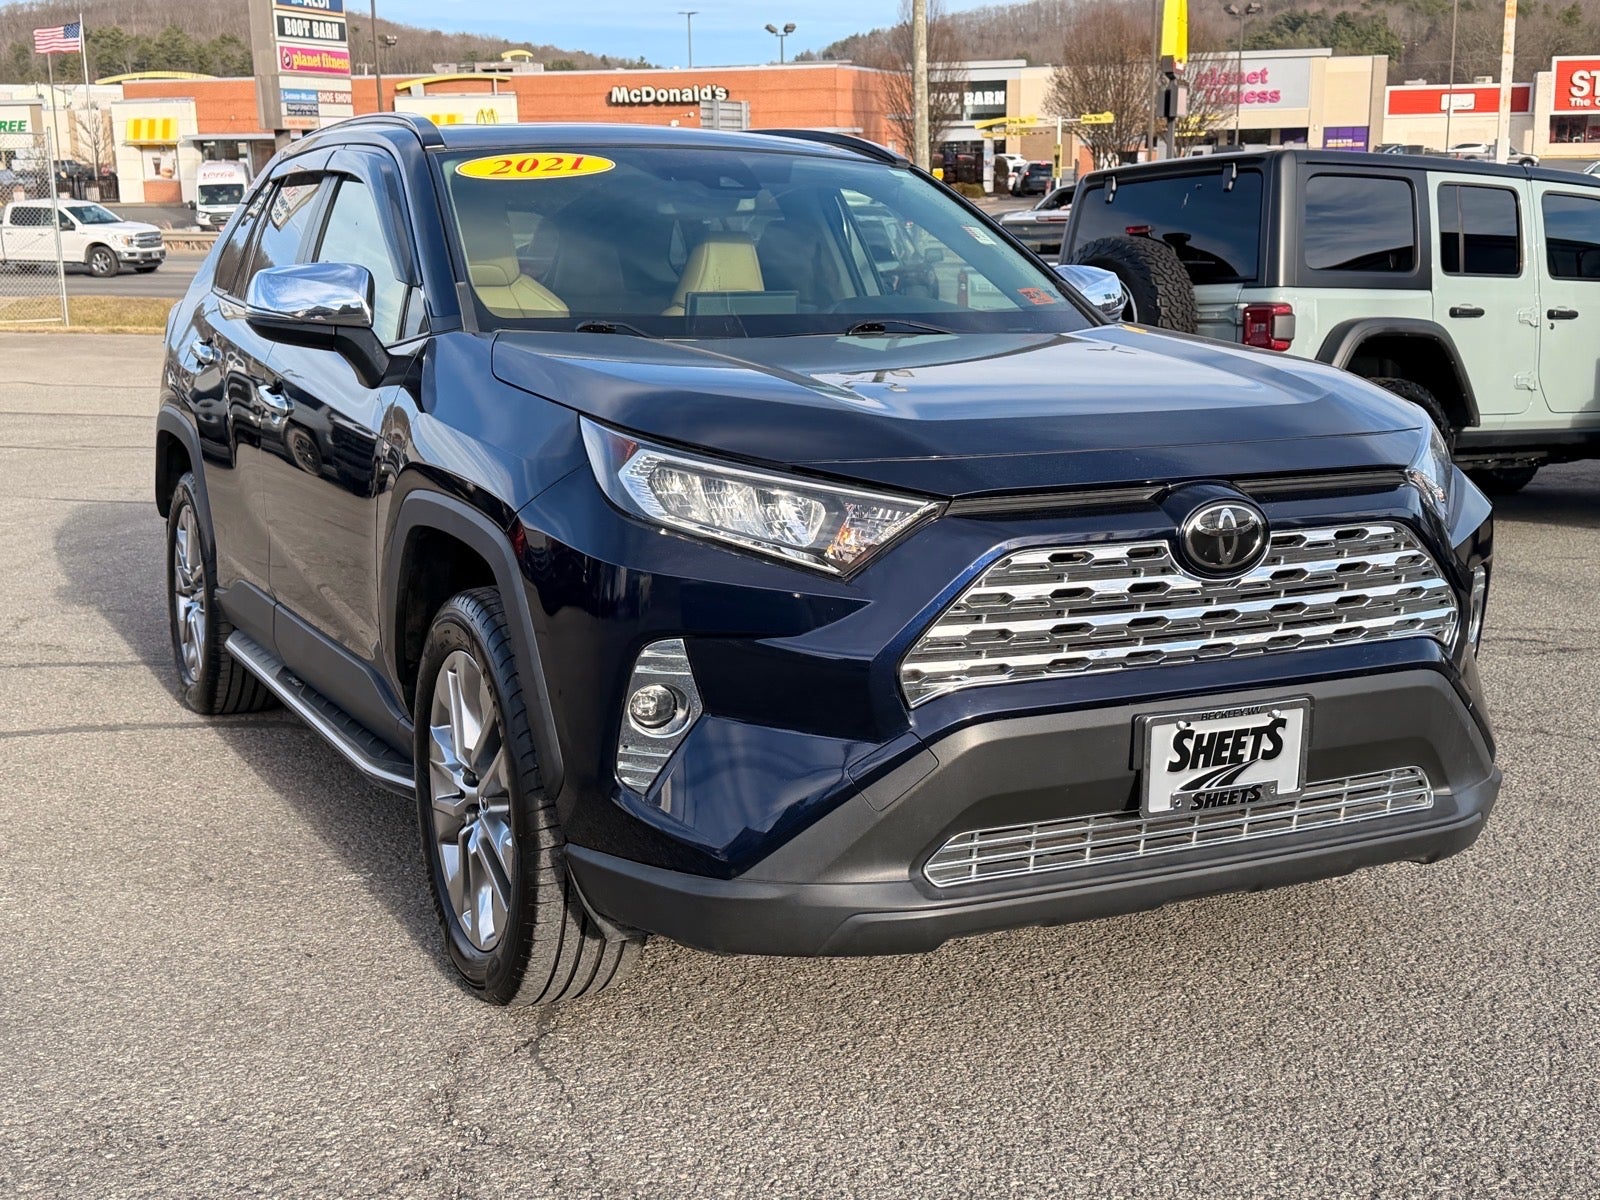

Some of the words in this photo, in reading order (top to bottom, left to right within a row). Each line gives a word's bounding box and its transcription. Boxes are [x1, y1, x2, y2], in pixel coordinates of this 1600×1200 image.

[284, 17, 310, 37] BOOT
[312, 21, 340, 40] BARN
[292, 50, 321, 70] planet
[322, 52, 350, 70] fitness
[1194, 67, 1269, 90] planet
[610, 84, 728, 104] McDonald's
[963, 90, 1005, 106] BARN
[1569, 98, 1591, 107] The
[489, 157, 584, 175] 2021
[1167, 718, 1288, 772] SHEETS
[1190, 784, 1263, 811] SHEETS
